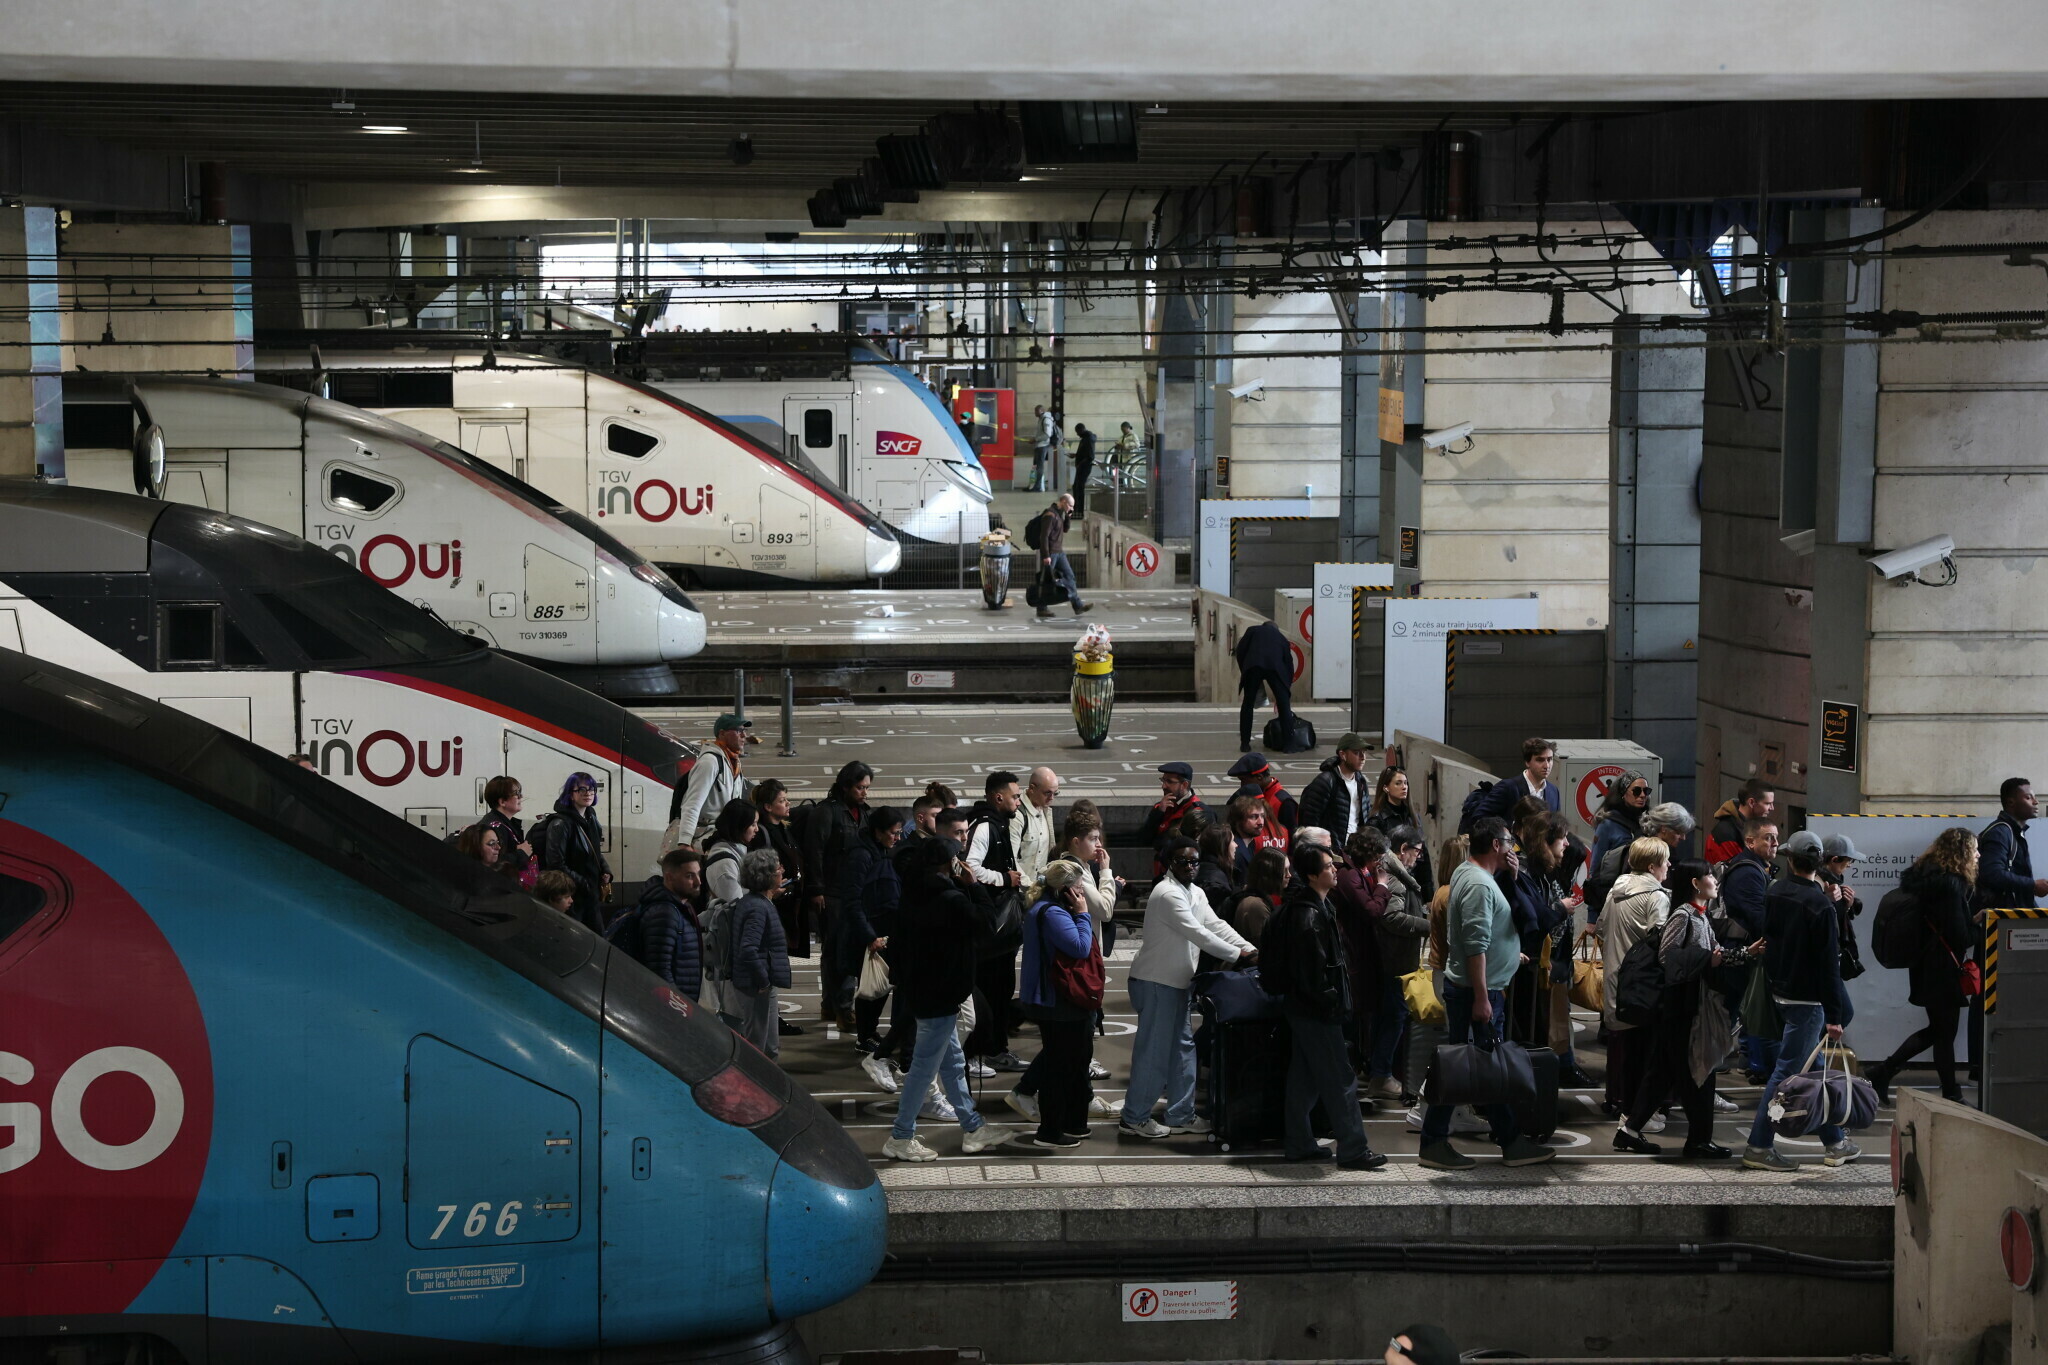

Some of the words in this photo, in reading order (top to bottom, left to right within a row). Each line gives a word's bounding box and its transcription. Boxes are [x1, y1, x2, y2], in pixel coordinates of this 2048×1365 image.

[878, 440, 919, 453] SNCF
[599, 471, 632, 483] TGV
[314, 524, 356, 540] TGV
[767, 533, 794, 544] 893
[319, 534, 463, 589] nOui
[533, 605, 566, 619] 885
[1412, 621, 1435, 629] Accès
[1447, 621, 1465, 629] train
[1465, 620, 1494, 631] jusqu'à
[519, 632, 537, 640] TGV
[538, 631, 568, 640] 310369
[310, 718, 354, 735] TGV
[1597, 767, 1623, 777] INTERD
[1891, 855, 1906, 864] au
[1851, 867, 1859, 879] 2
[1862, 867, 1902, 879] minut
[429, 1200, 523, 1240] 766
[416, 1271, 433, 1281] Rame
[435, 1269, 457, 1279] Grande
[458, 1267, 482, 1278] Vitesse
[424, 1281, 435, 1291] par
[436, 1279, 445, 1289] les
[491, 1274, 509, 1285] SNCF
[1162, 1289, 1192, 1298] Danger
